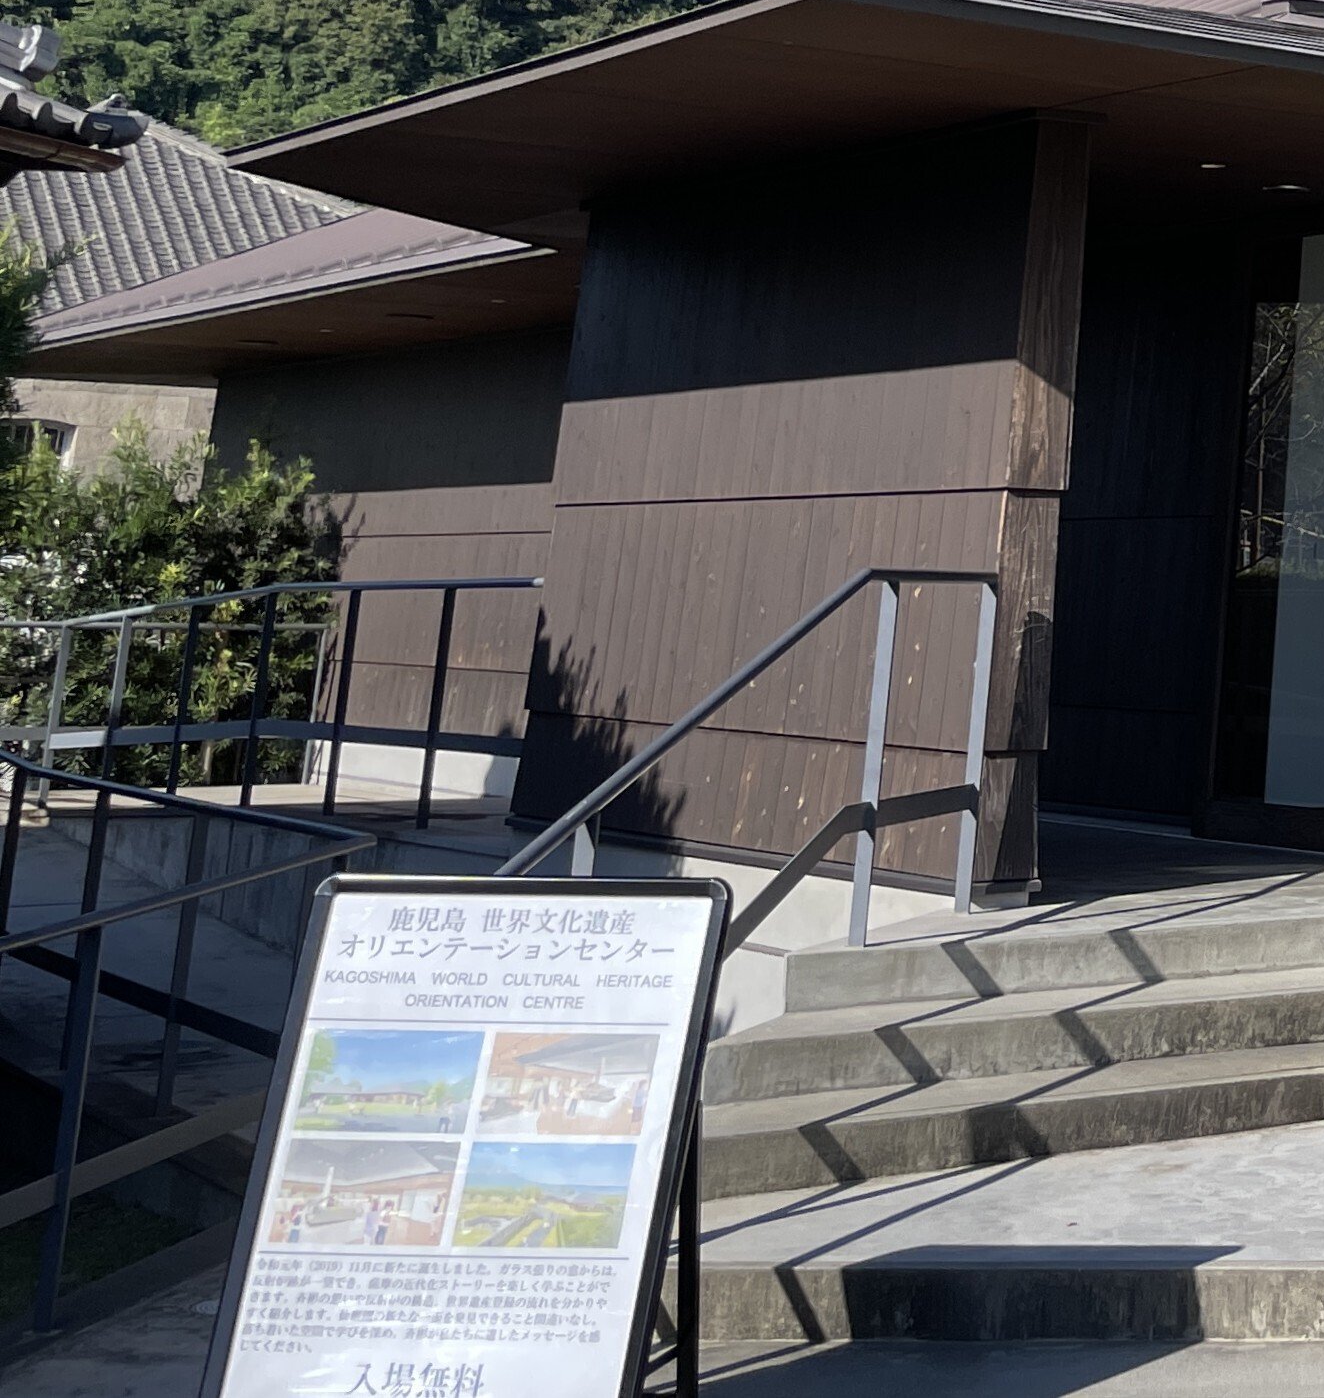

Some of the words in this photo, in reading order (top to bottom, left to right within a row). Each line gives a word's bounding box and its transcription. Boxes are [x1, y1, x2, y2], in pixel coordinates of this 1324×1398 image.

[387, 907, 467, 934] 鹿児島
[482, 908, 636, 936] 世界文化遺産
[337, 934, 676, 963] オリエンテーションセンター
[324, 970, 417, 985] KAGOSHIMA
[431, 972, 488, 987] WORLD
[502, 973, 582, 988] CULTURAL
[596, 974, 674, 989] HERITAGE
[404, 993, 509, 1009] ORIENTATION
[522, 995, 585, 1010] CENTRE
[346, 1363, 485, 1398] 入場無料
